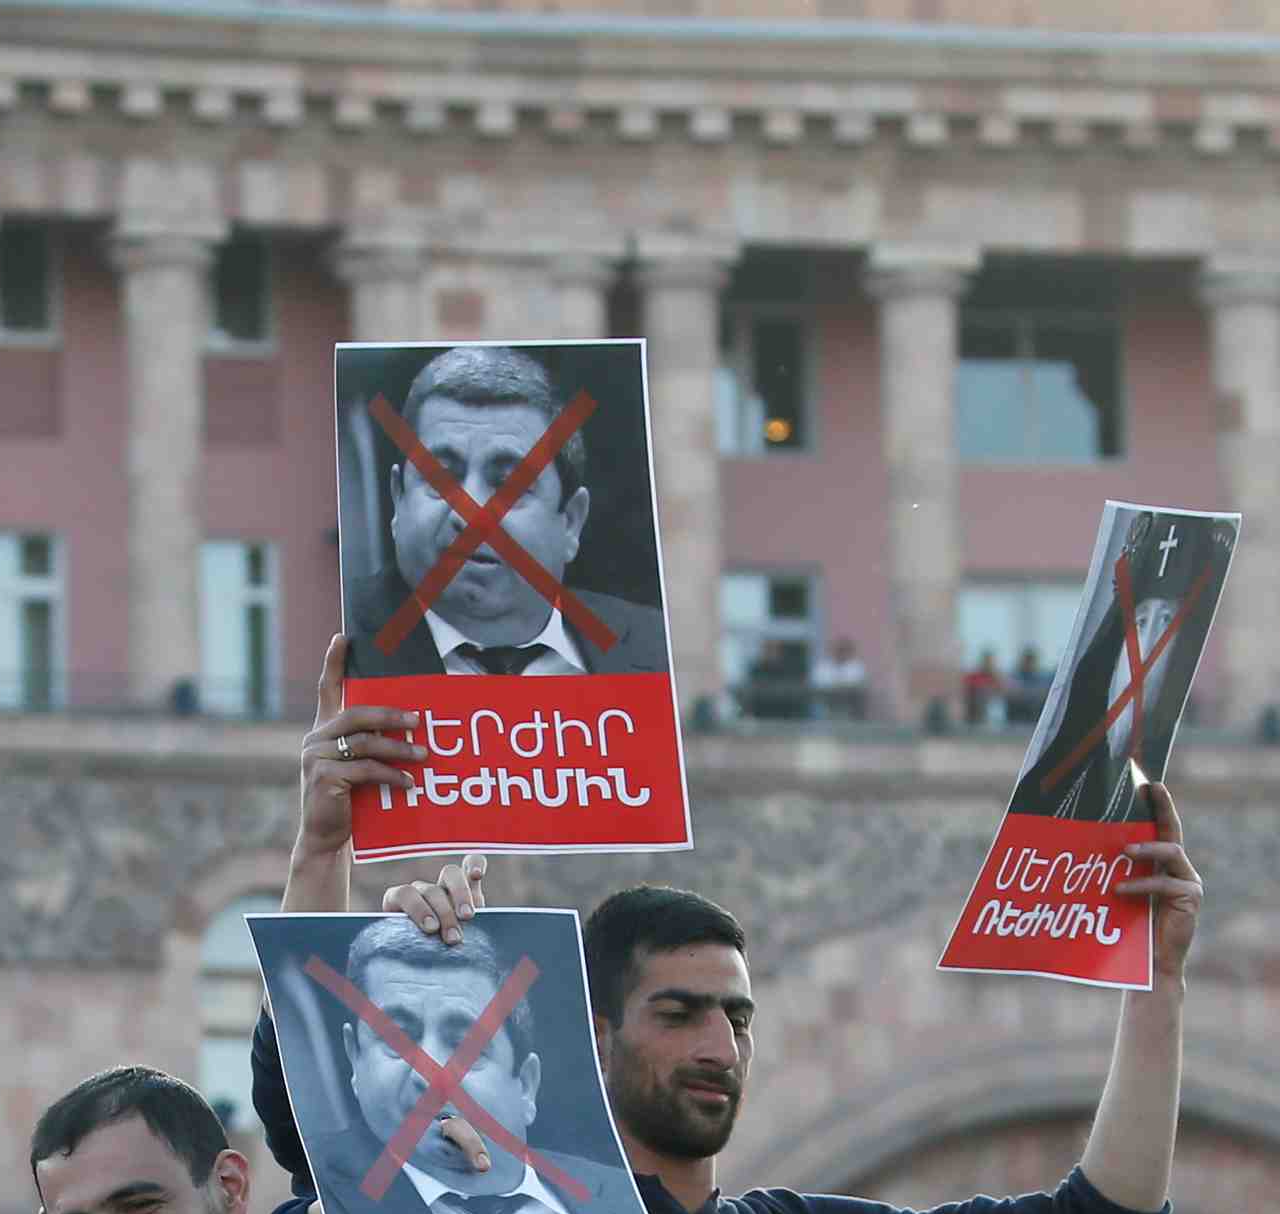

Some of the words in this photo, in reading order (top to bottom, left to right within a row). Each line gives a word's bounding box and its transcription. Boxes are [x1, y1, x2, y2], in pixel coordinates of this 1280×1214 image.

[404, 708, 635, 759] ԵՐԺԻՐ
[995, 847, 1133, 896] ՄԵՐԺԻՐ
[972, 899, 1121, 945] ՌԵԺԻՄԻՆ
